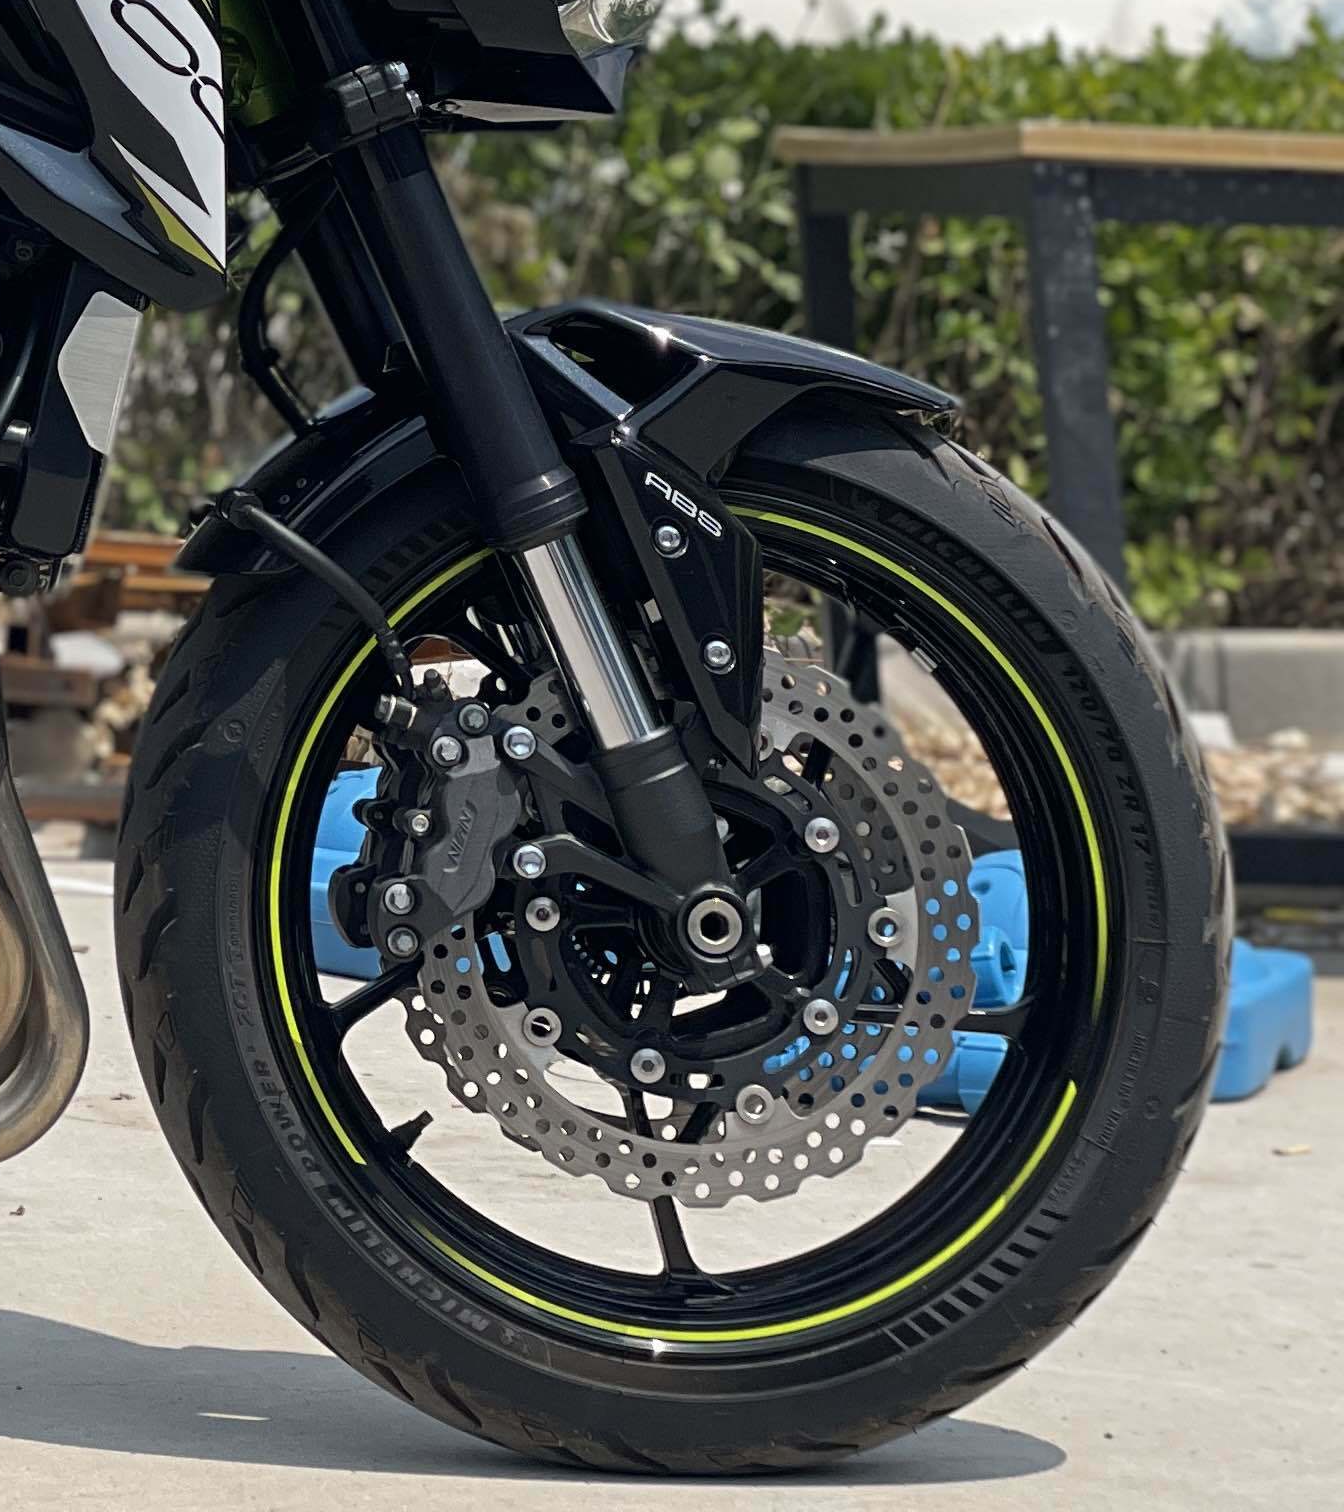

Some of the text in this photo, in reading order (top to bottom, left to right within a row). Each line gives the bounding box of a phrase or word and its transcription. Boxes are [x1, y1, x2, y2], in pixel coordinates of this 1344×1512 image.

[643, 472, 724, 536] ABS
[887, 506, 1056, 651] MICHELIN
[1115, 770, 1144, 817] ZR
[1129, 821, 1152, 859] 17
[324, 1193, 493, 1334] MICHELIN
